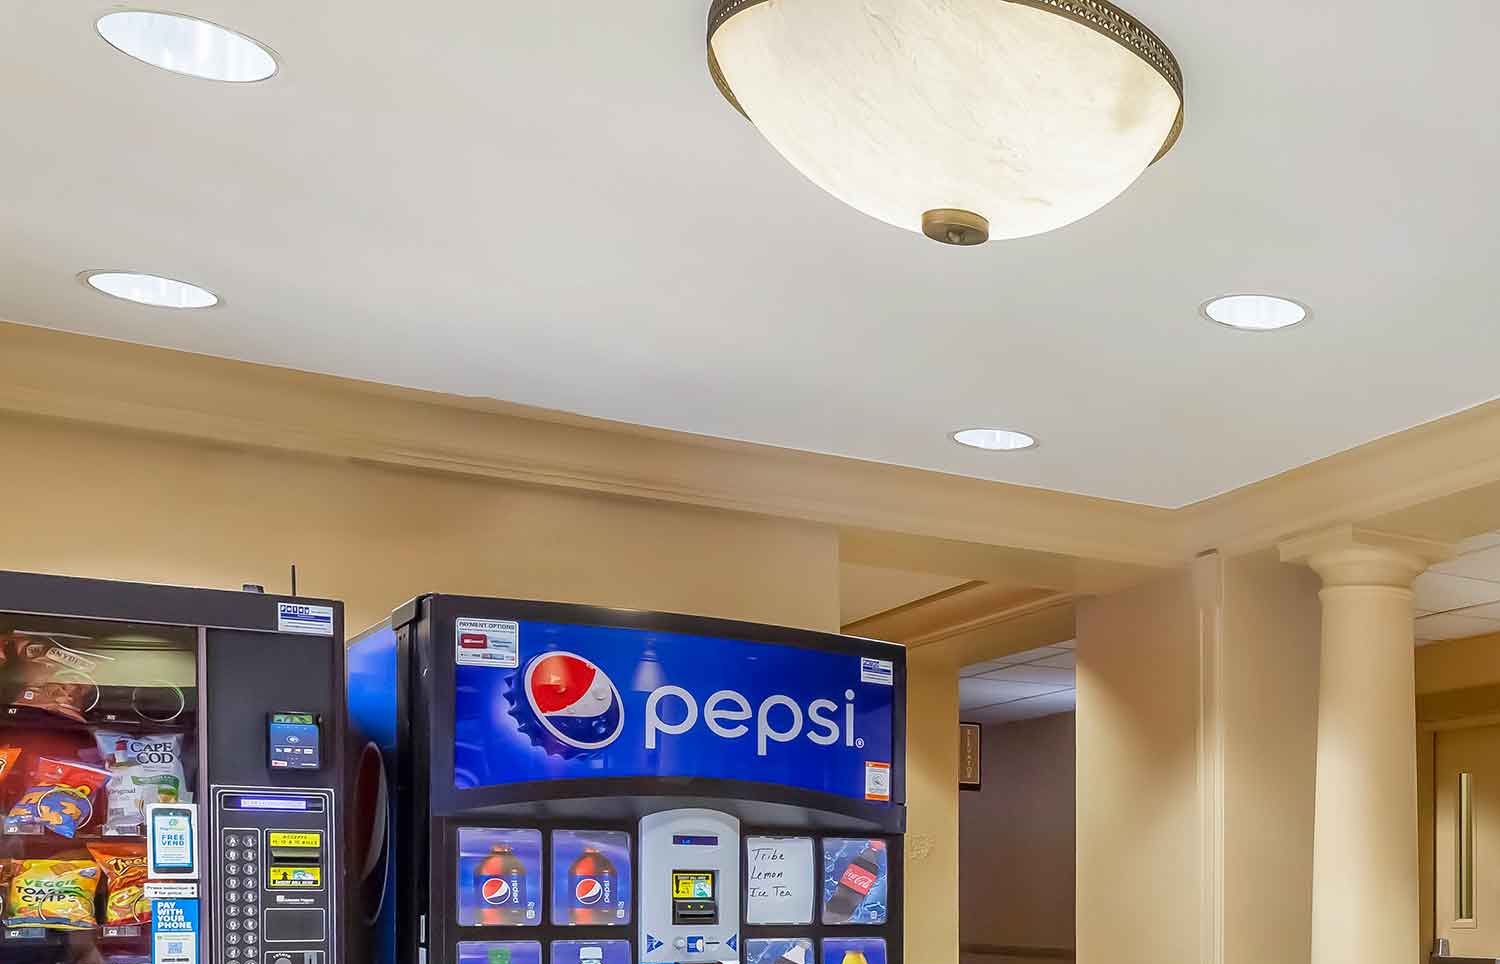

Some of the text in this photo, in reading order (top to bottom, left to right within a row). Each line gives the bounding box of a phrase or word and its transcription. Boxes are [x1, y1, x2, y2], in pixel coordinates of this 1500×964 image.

[645, 685, 855, 756] pepsi
[130, 742, 174, 752] CAPE
[136, 752, 174, 764] COD
[752, 848, 785, 861] Tribe
[106, 856, 148, 877] Chee
[751, 866, 783, 880] Lemon
[511, 880, 520, 904] pepsi
[603, 880, 611, 903] pepsi
[749, 885, 792, 897] Ice Tea
